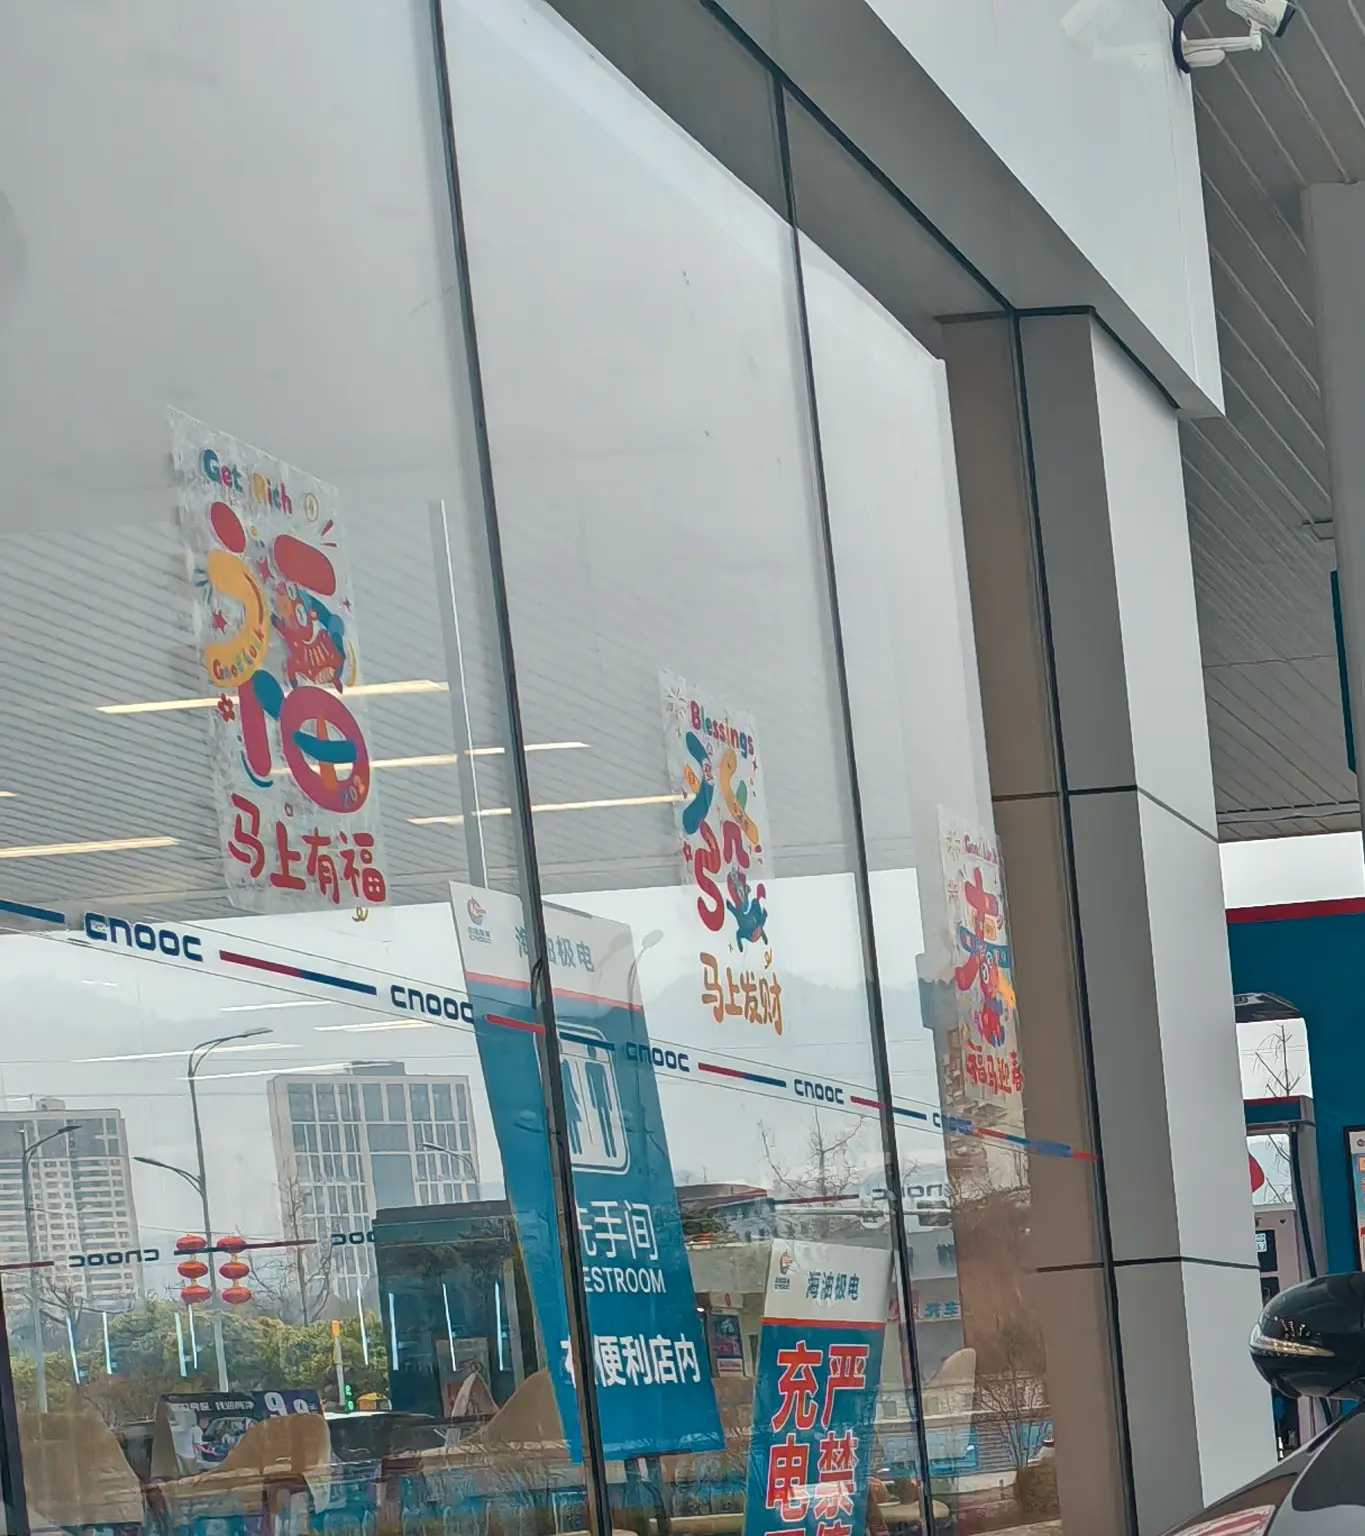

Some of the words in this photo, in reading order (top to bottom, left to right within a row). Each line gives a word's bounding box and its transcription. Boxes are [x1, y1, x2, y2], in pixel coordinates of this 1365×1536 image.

[202, 448, 244, 493] Get
[689, 700, 754, 759] Blessings
[227, 793, 387, 904] 马上有福
[700, 951, 783, 1036] 马上发财
[582, 1267, 667, 1293] ESTROOM
